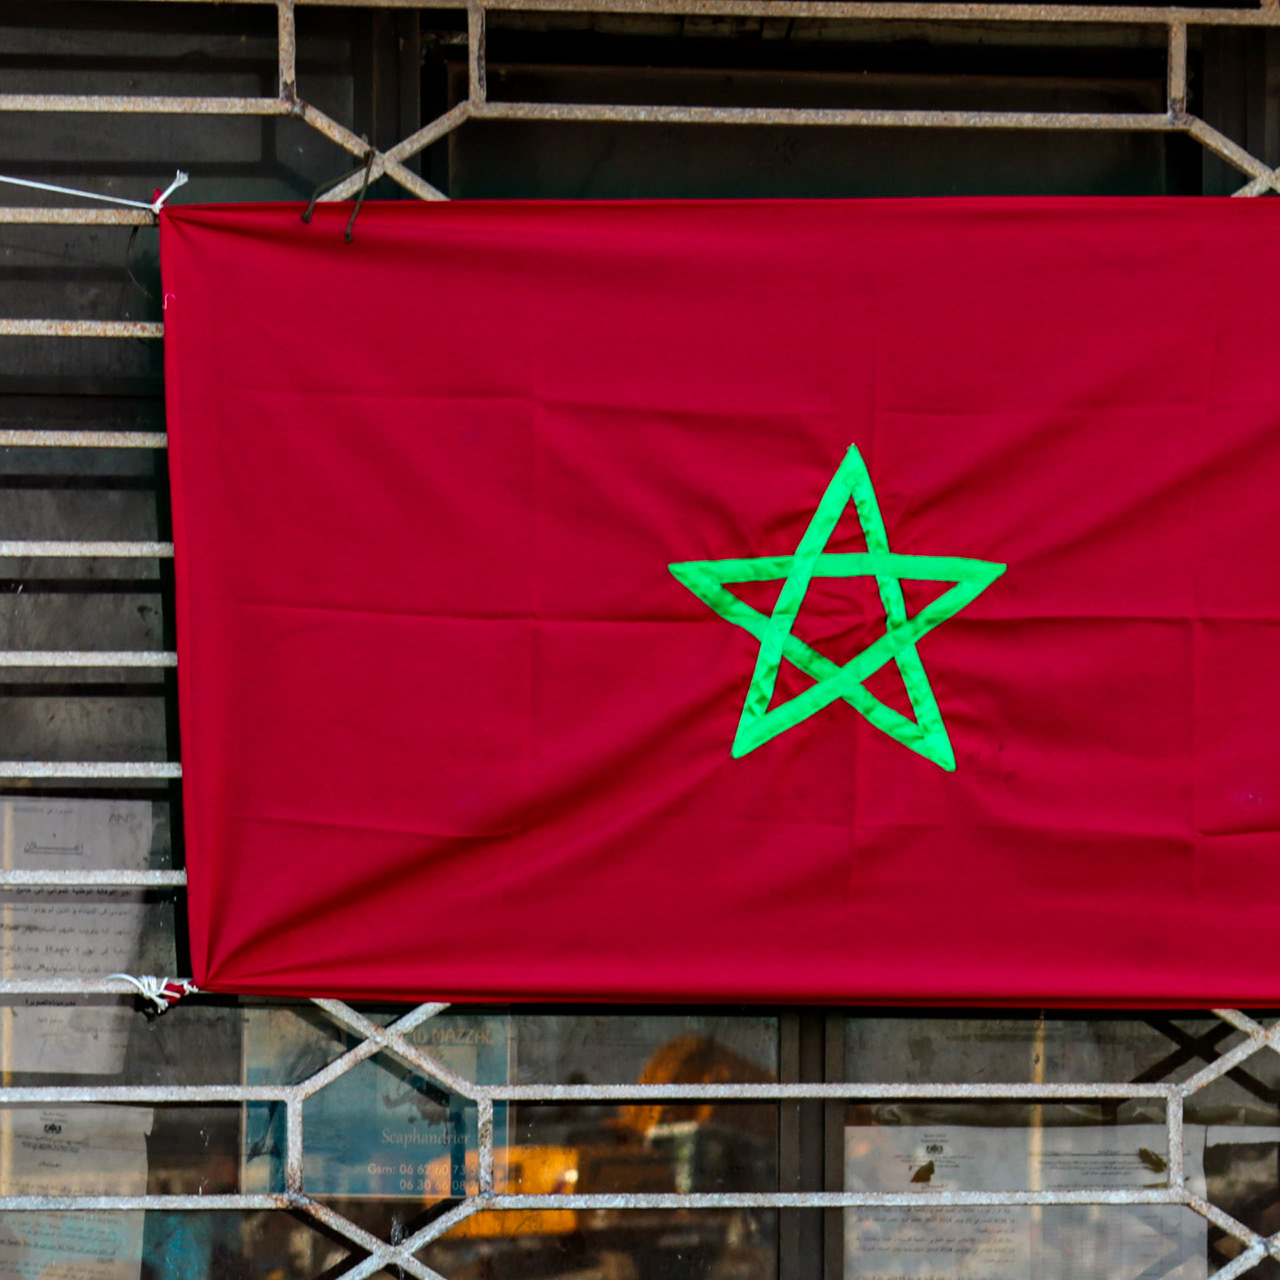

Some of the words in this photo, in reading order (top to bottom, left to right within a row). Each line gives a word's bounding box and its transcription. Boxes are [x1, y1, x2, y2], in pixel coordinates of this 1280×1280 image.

[381, 1125, 471, 1148] Scaphandrier
[399, 1164, 413, 1175] 06
[399, 1179, 413, 1191] 06
